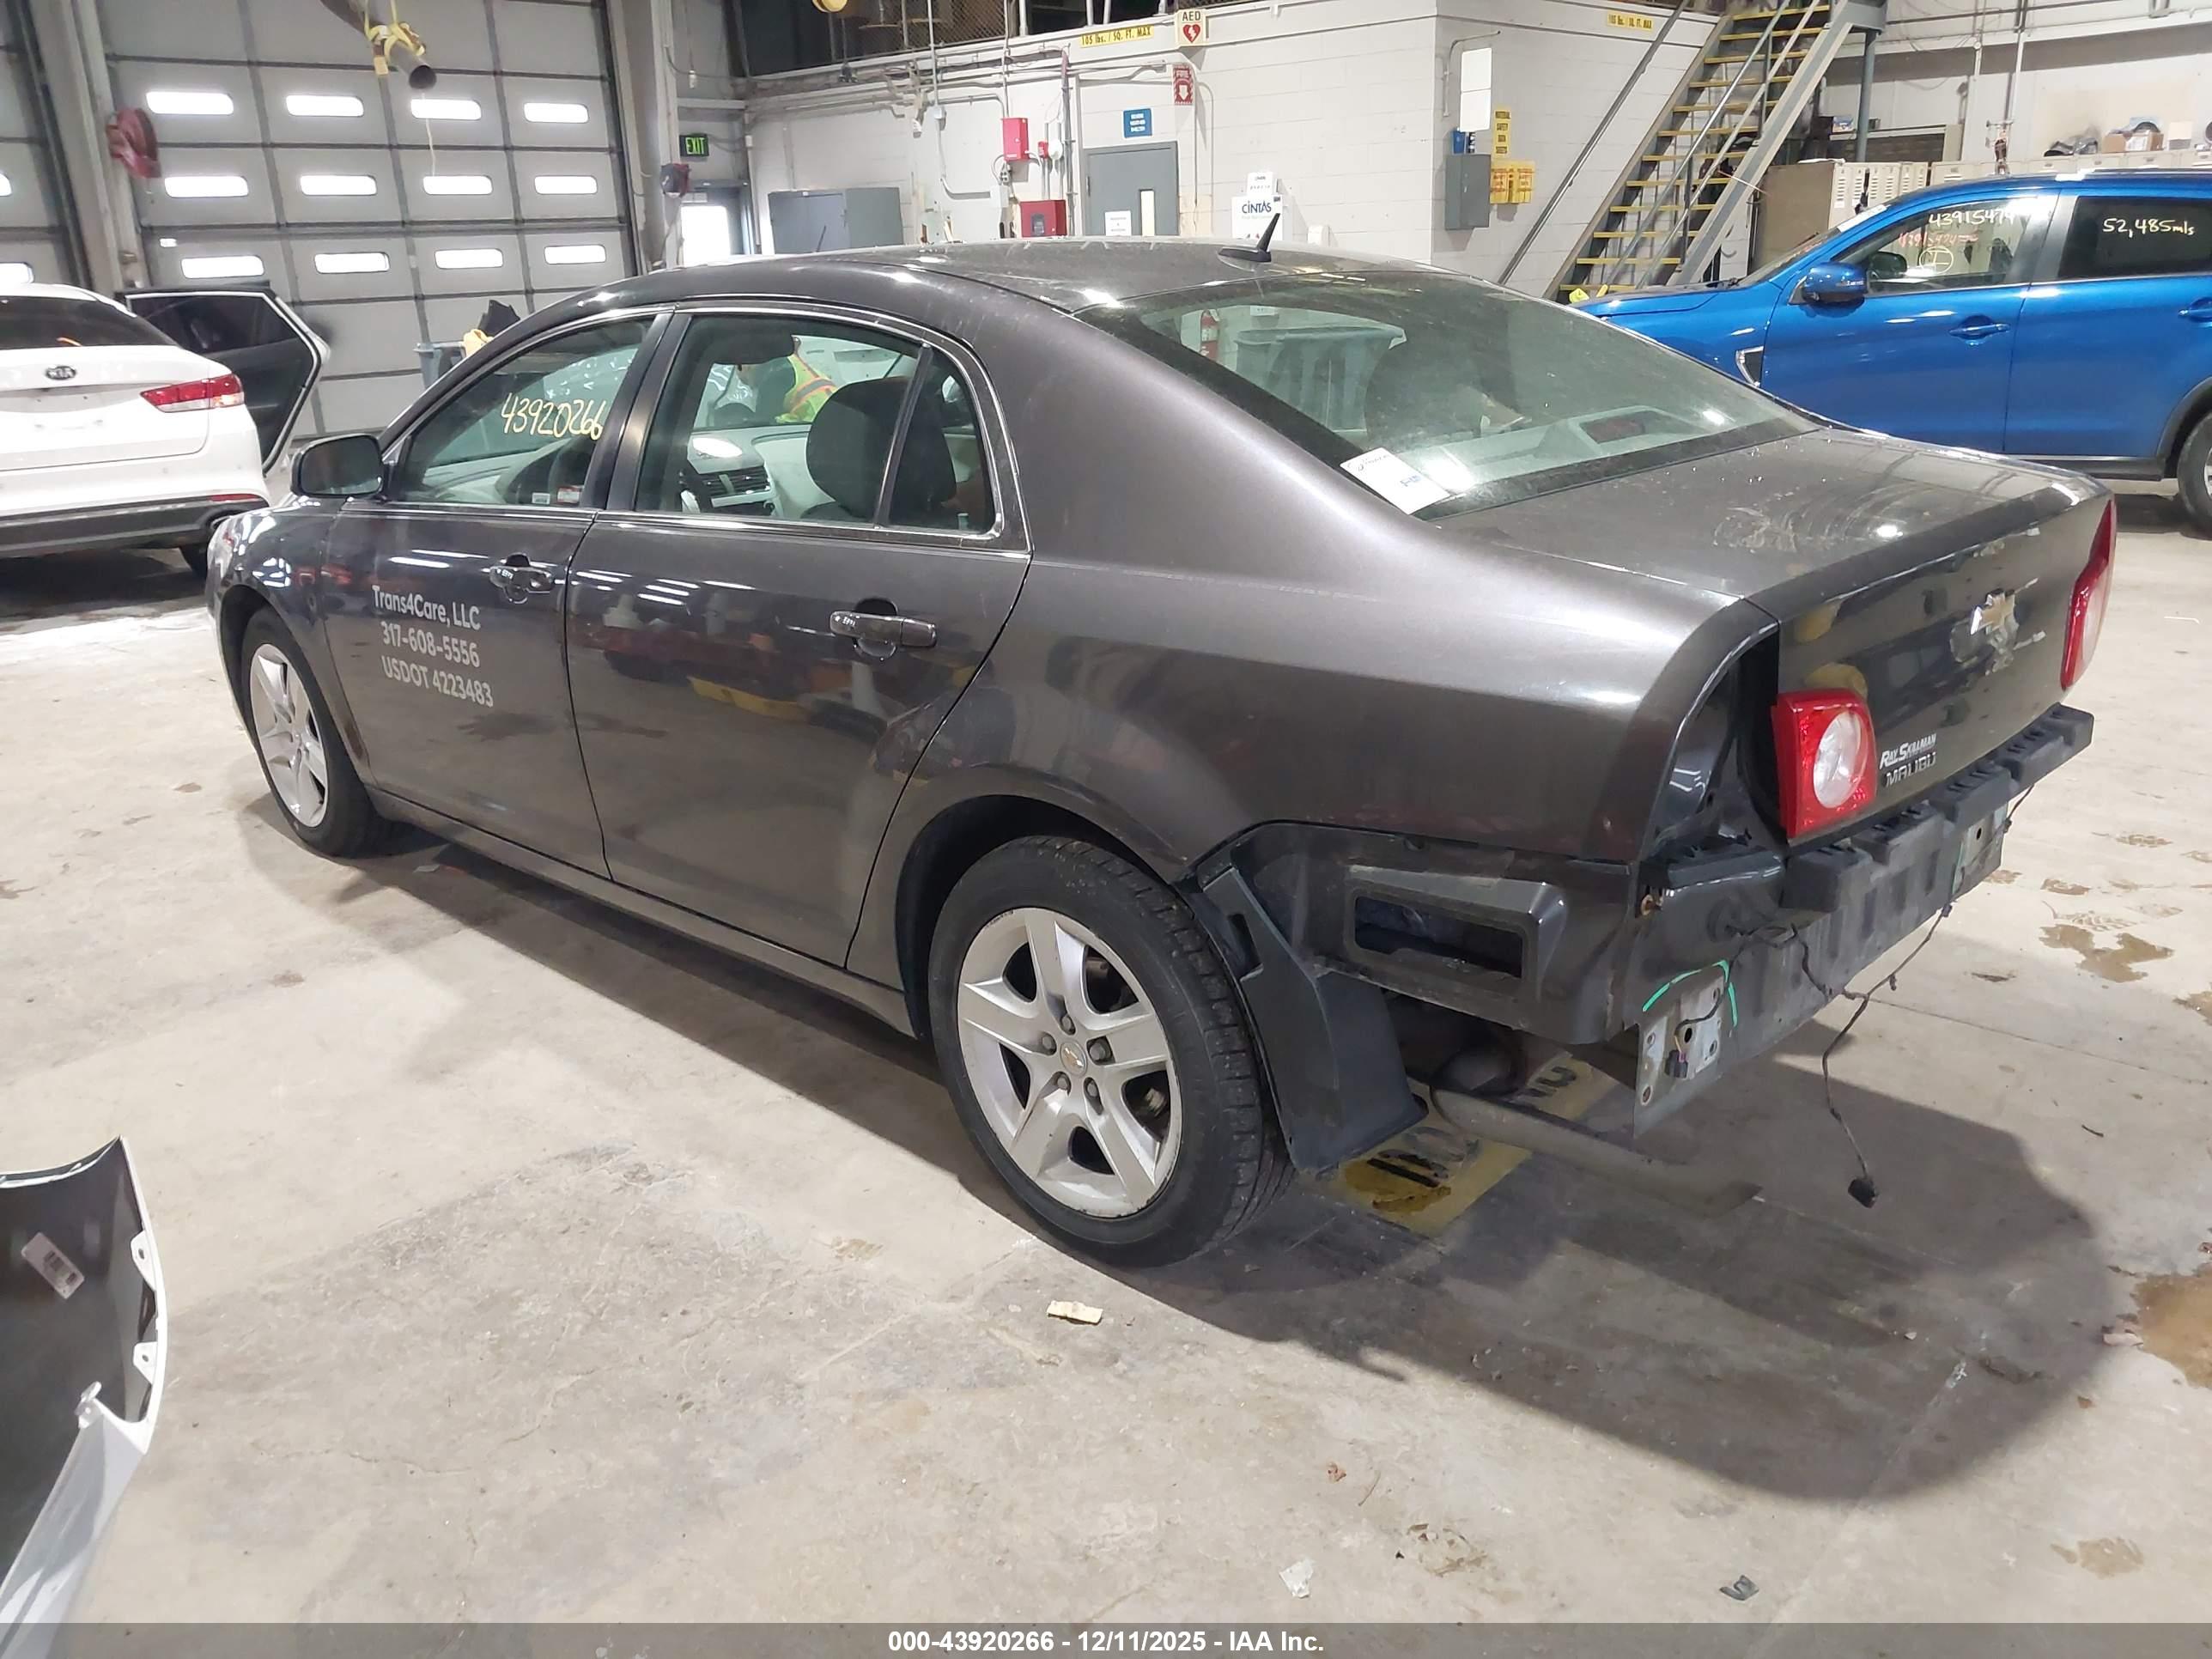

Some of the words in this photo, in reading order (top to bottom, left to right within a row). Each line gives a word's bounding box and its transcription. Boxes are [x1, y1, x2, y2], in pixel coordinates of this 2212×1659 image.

[1182, 10, 1201, 21] AED
[1082, 34, 1093, 46] 105
[1136, 26, 1151, 36] MAX
[685, 137, 705, 155] EXIT
[501, 392, 607, 441] 43920266
[372, 585, 451, 628] Trans4Care,
[452, 602, 482, 630] LLC
[380, 621, 480, 668] 317-608-5556
[381, 655, 430, 690] USDOT
[432, 670, 494, 708] 4223483
[1885, 751, 1936, 787] MALIBU
